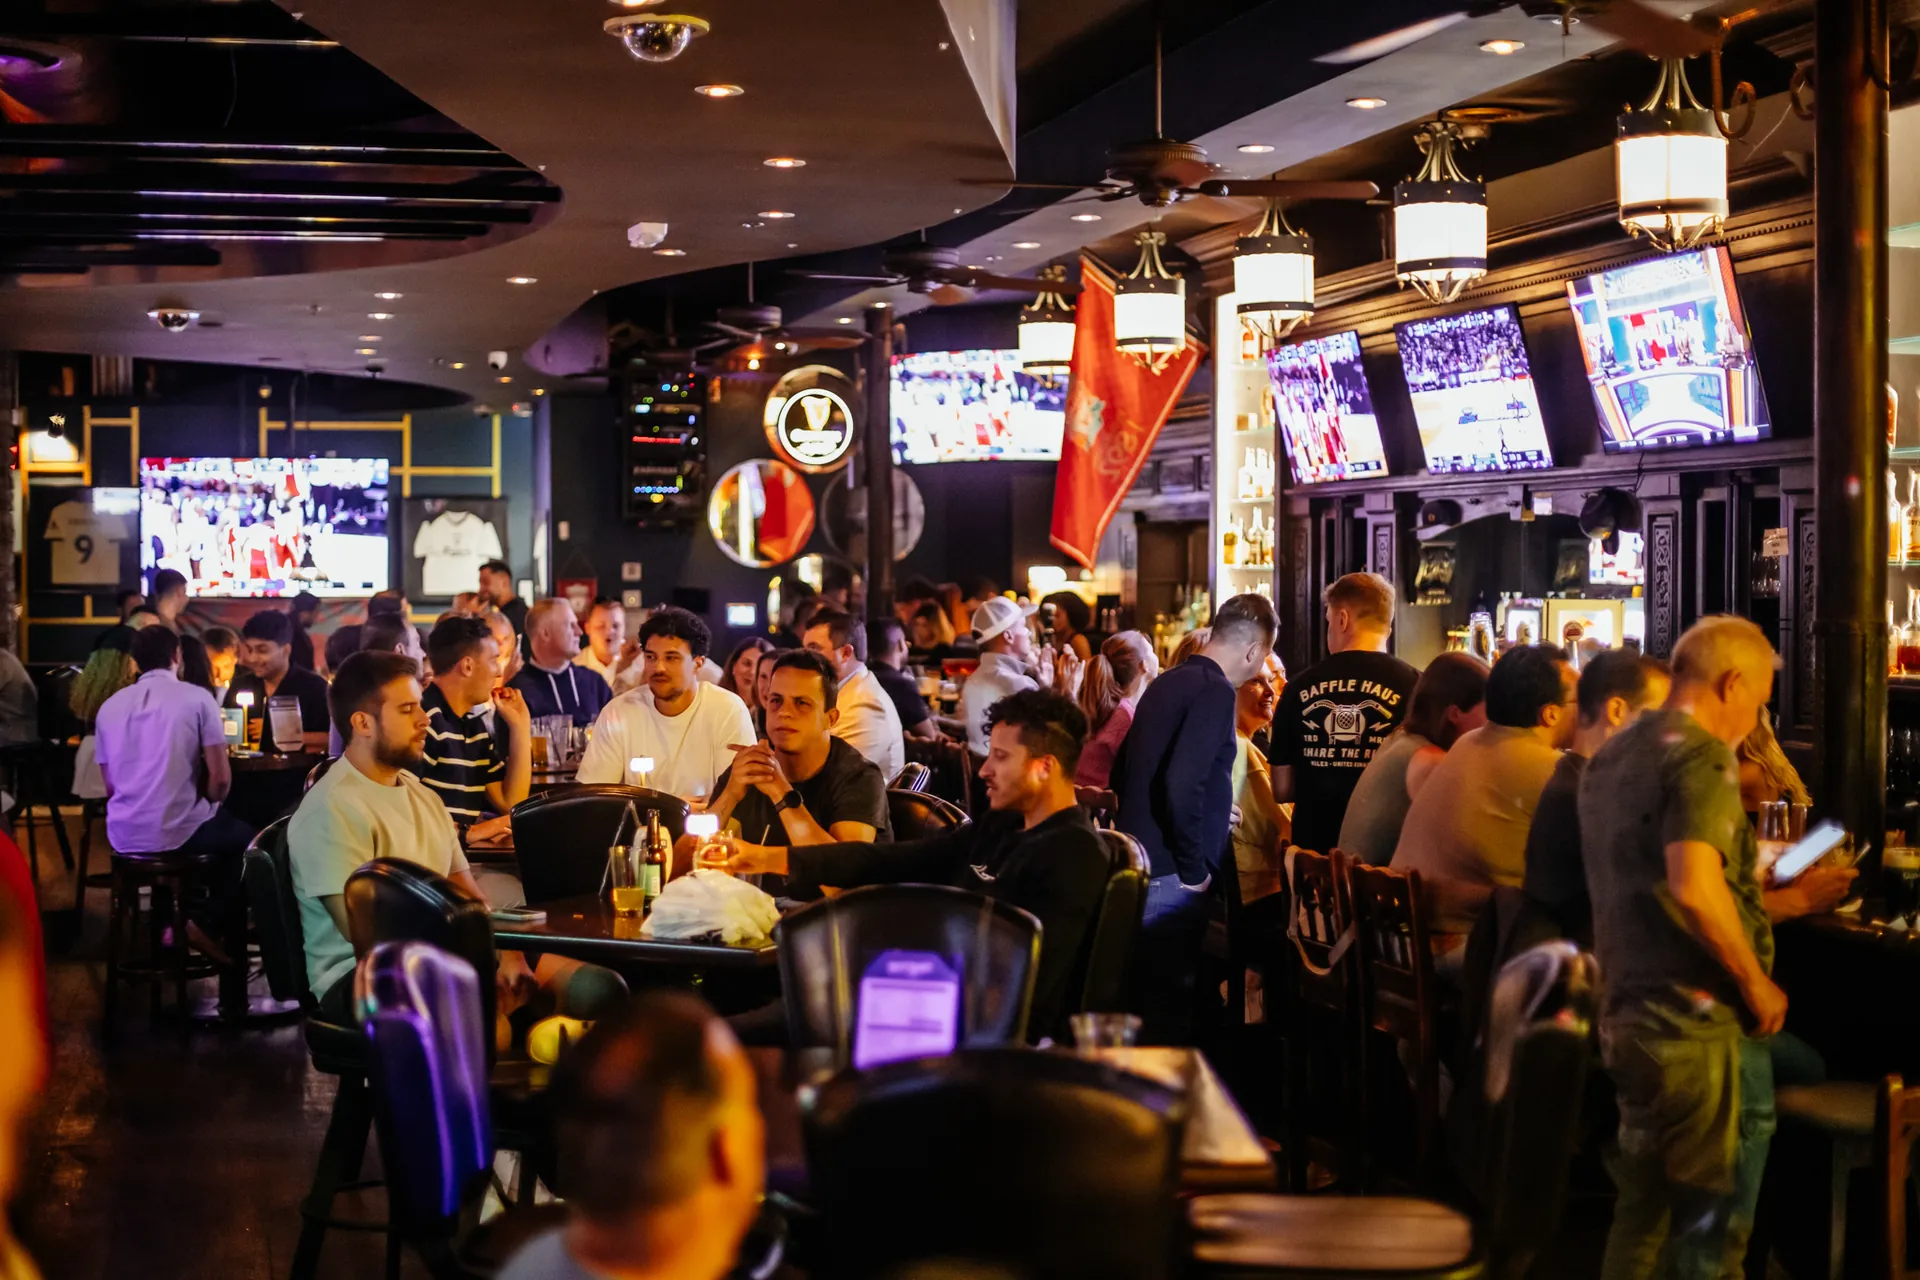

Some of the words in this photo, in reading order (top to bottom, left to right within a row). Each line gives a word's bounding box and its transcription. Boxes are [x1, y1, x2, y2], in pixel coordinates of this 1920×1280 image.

[74, 534, 94, 565] 9
[1299, 679, 1357, 703] BAFFLE
[1360, 680, 1401, 706] HAUS
[1341, 748, 1360, 759] THE
